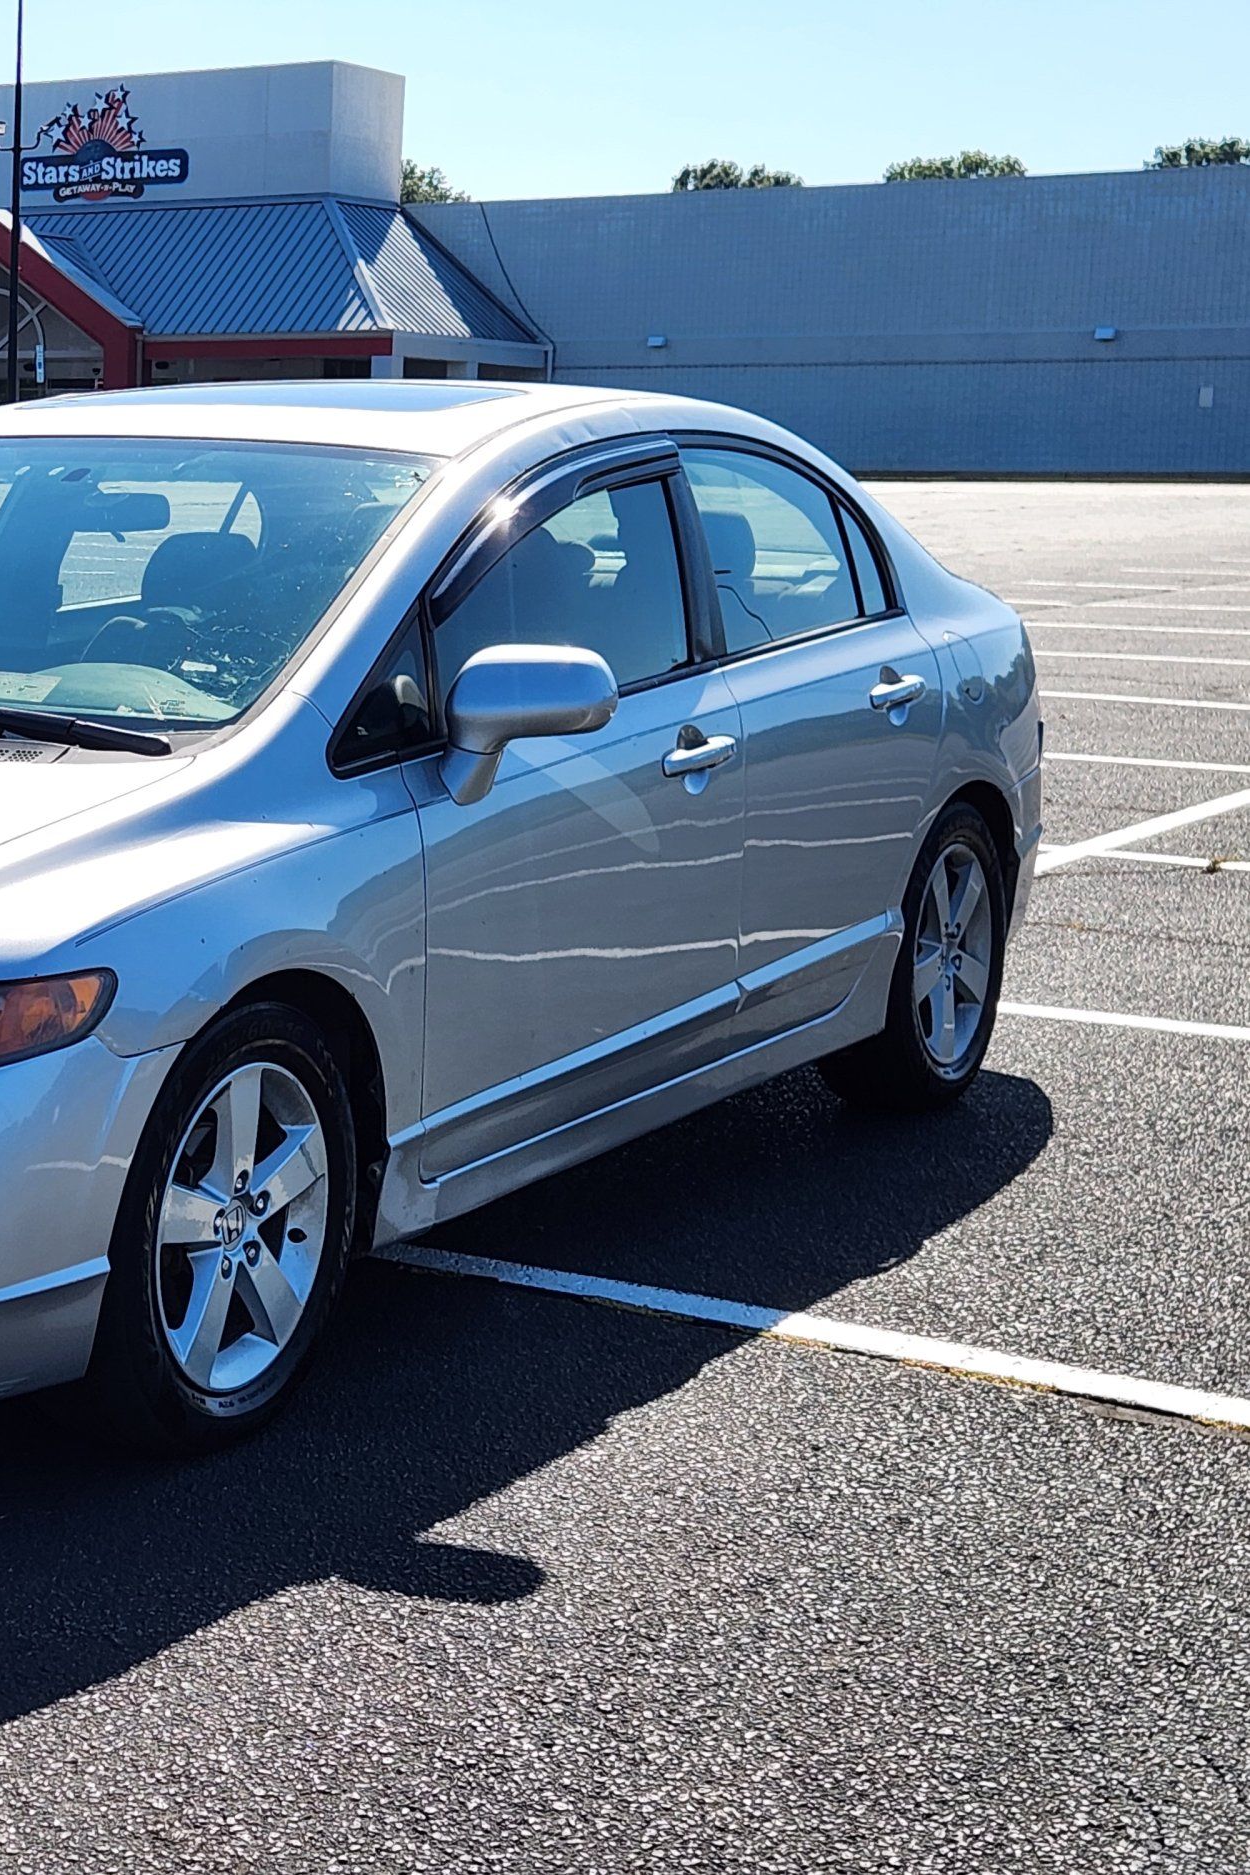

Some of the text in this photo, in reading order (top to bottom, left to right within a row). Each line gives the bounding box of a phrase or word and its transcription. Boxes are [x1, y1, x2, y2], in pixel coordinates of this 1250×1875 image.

[23, 154, 181, 185] Stars AND Strikes
